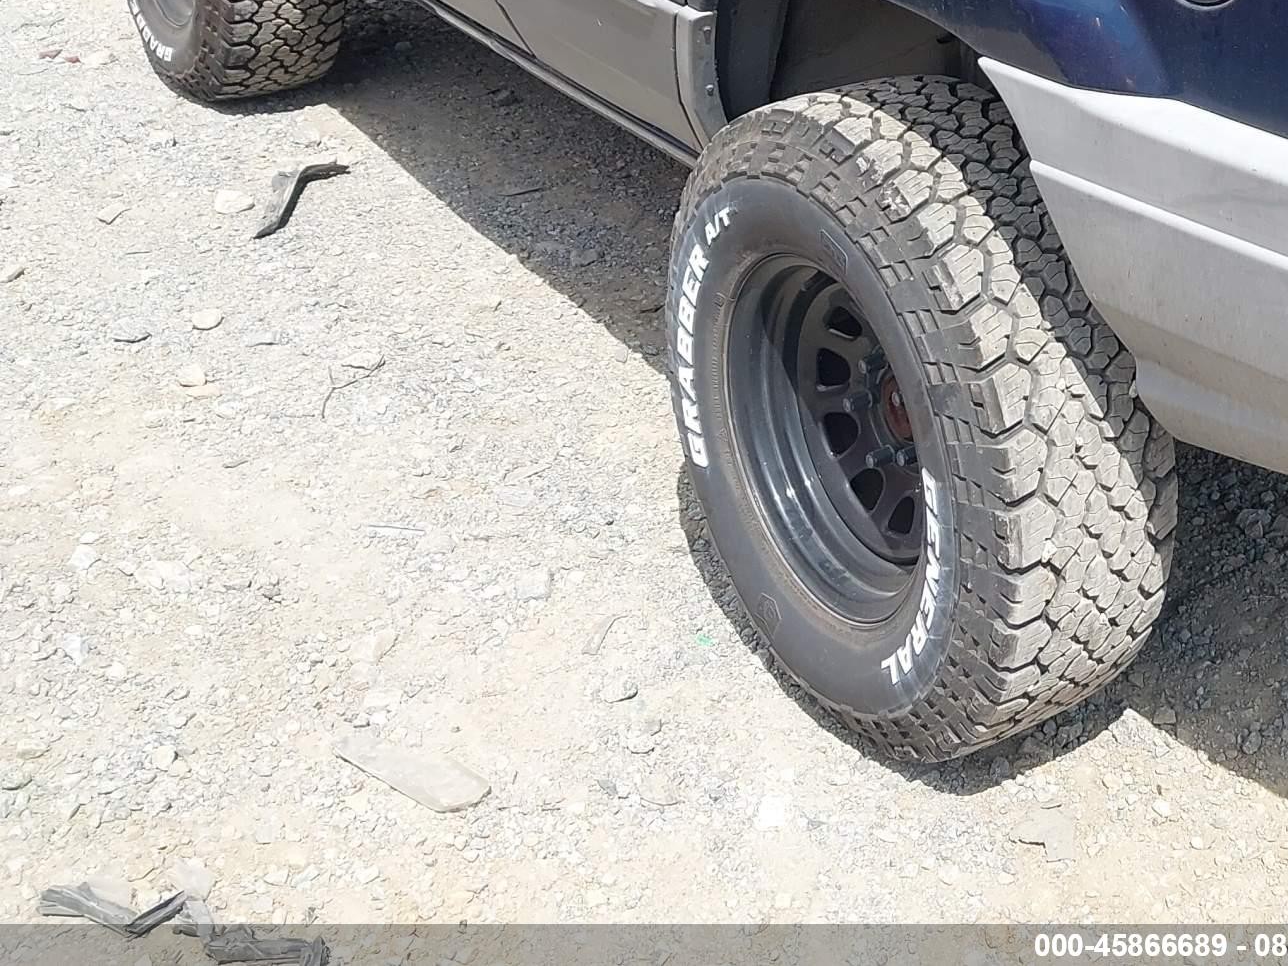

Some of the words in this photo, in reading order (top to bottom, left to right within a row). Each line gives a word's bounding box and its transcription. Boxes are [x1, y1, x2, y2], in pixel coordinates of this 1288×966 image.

[676, 243, 710, 468] GRABBER
[704, 206, 731, 246] A/T
[881, 467, 942, 685] GENERAL
